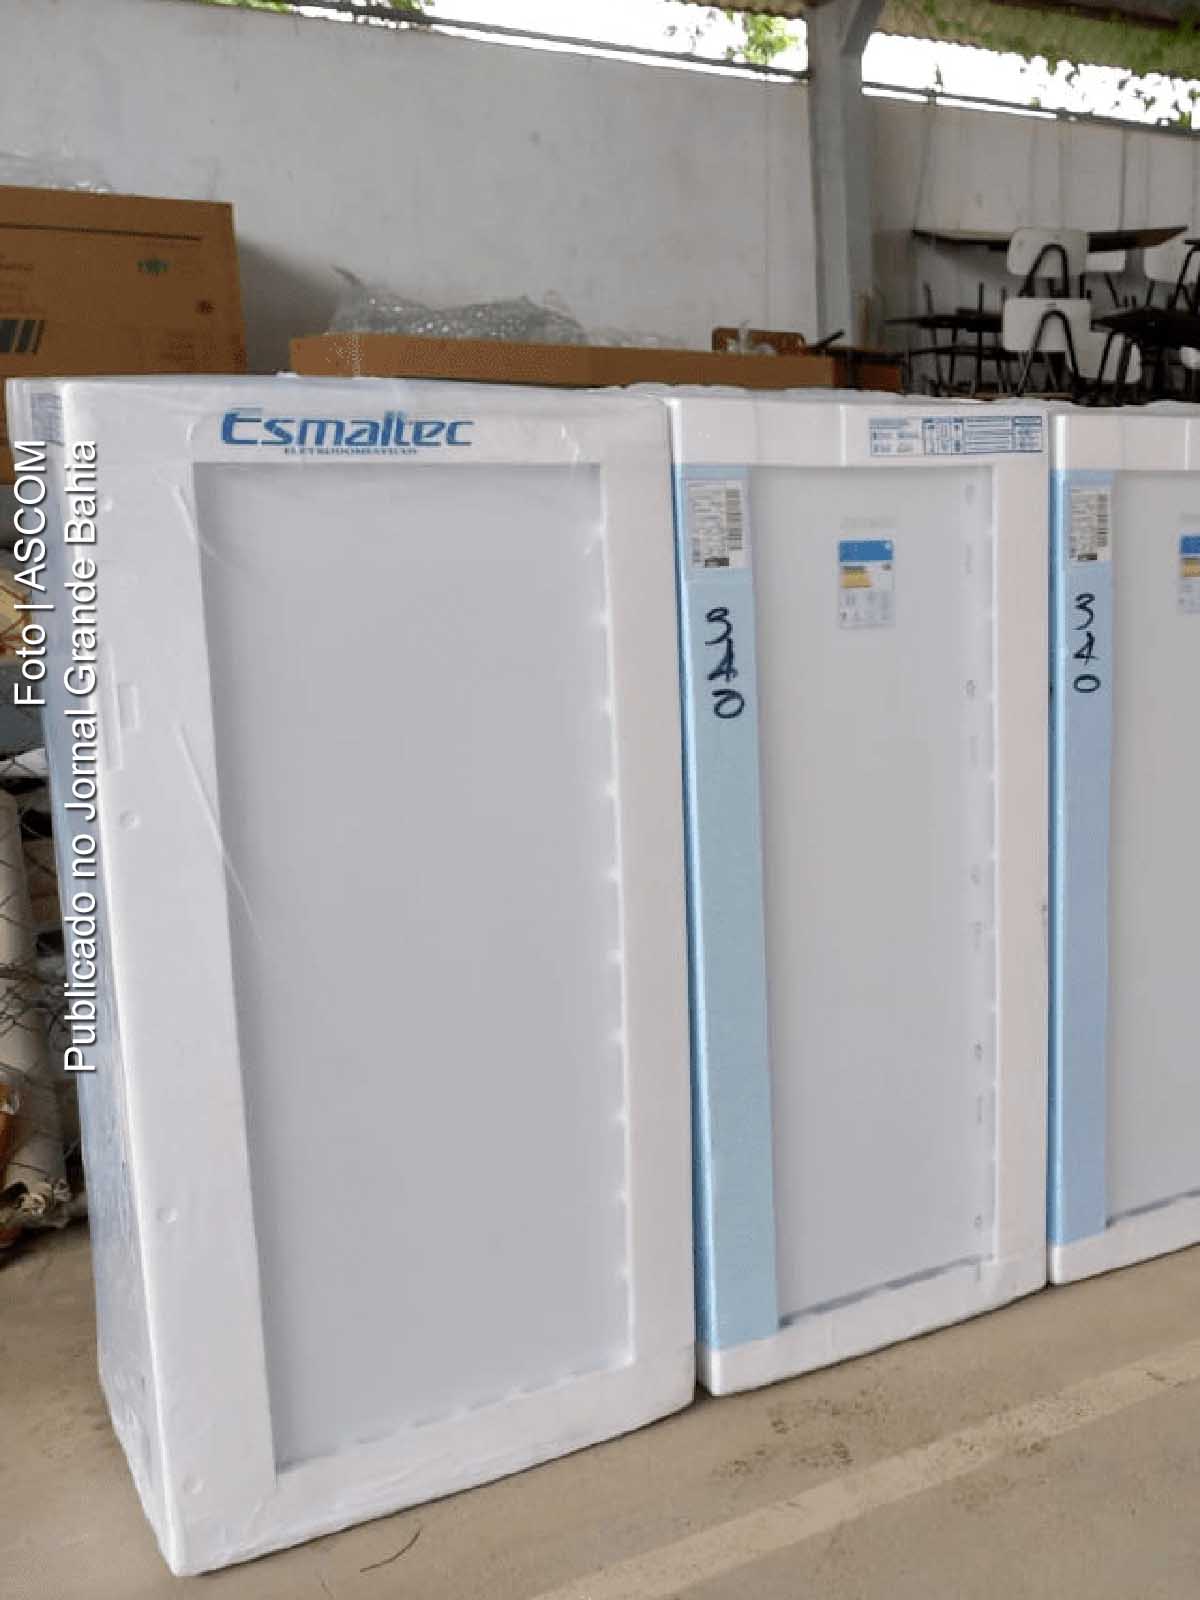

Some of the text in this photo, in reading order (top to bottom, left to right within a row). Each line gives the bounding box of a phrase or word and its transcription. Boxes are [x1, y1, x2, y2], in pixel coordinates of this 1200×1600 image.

[221, 408, 474, 447] Esmaltec
[704, 606, 745, 719] 340
[1073, 593, 1100, 693] 340
